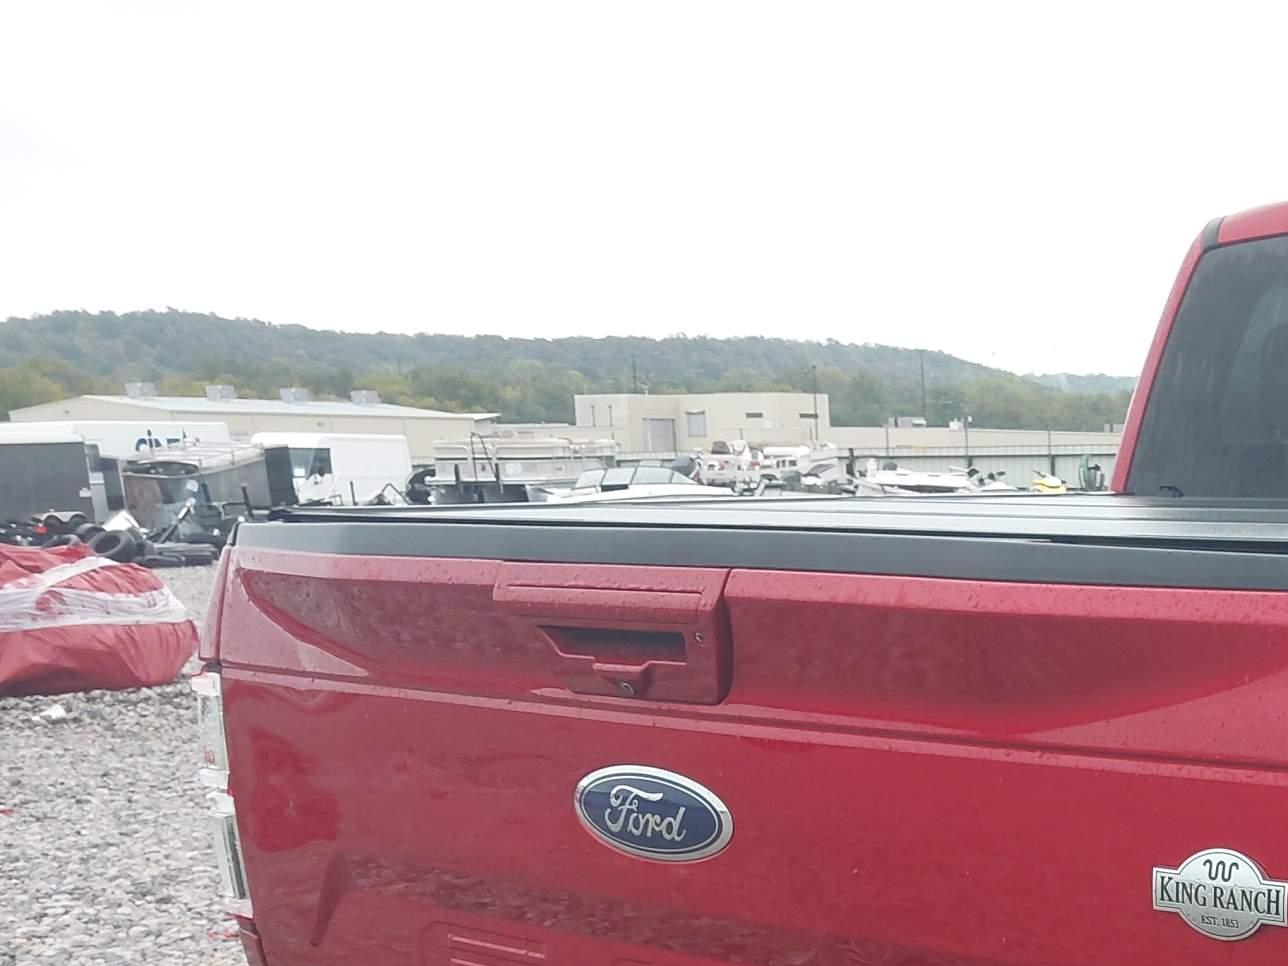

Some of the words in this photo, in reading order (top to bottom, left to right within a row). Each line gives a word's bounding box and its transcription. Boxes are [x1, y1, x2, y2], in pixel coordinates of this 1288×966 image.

[604, 784, 687, 842] Ford
[1159, 875, 1208, 908] KING
[1212, 886, 1282, 916] RANCH
[1201, 915, 1220, 927] EST.
[1222, 917, 1240, 929] 1853
